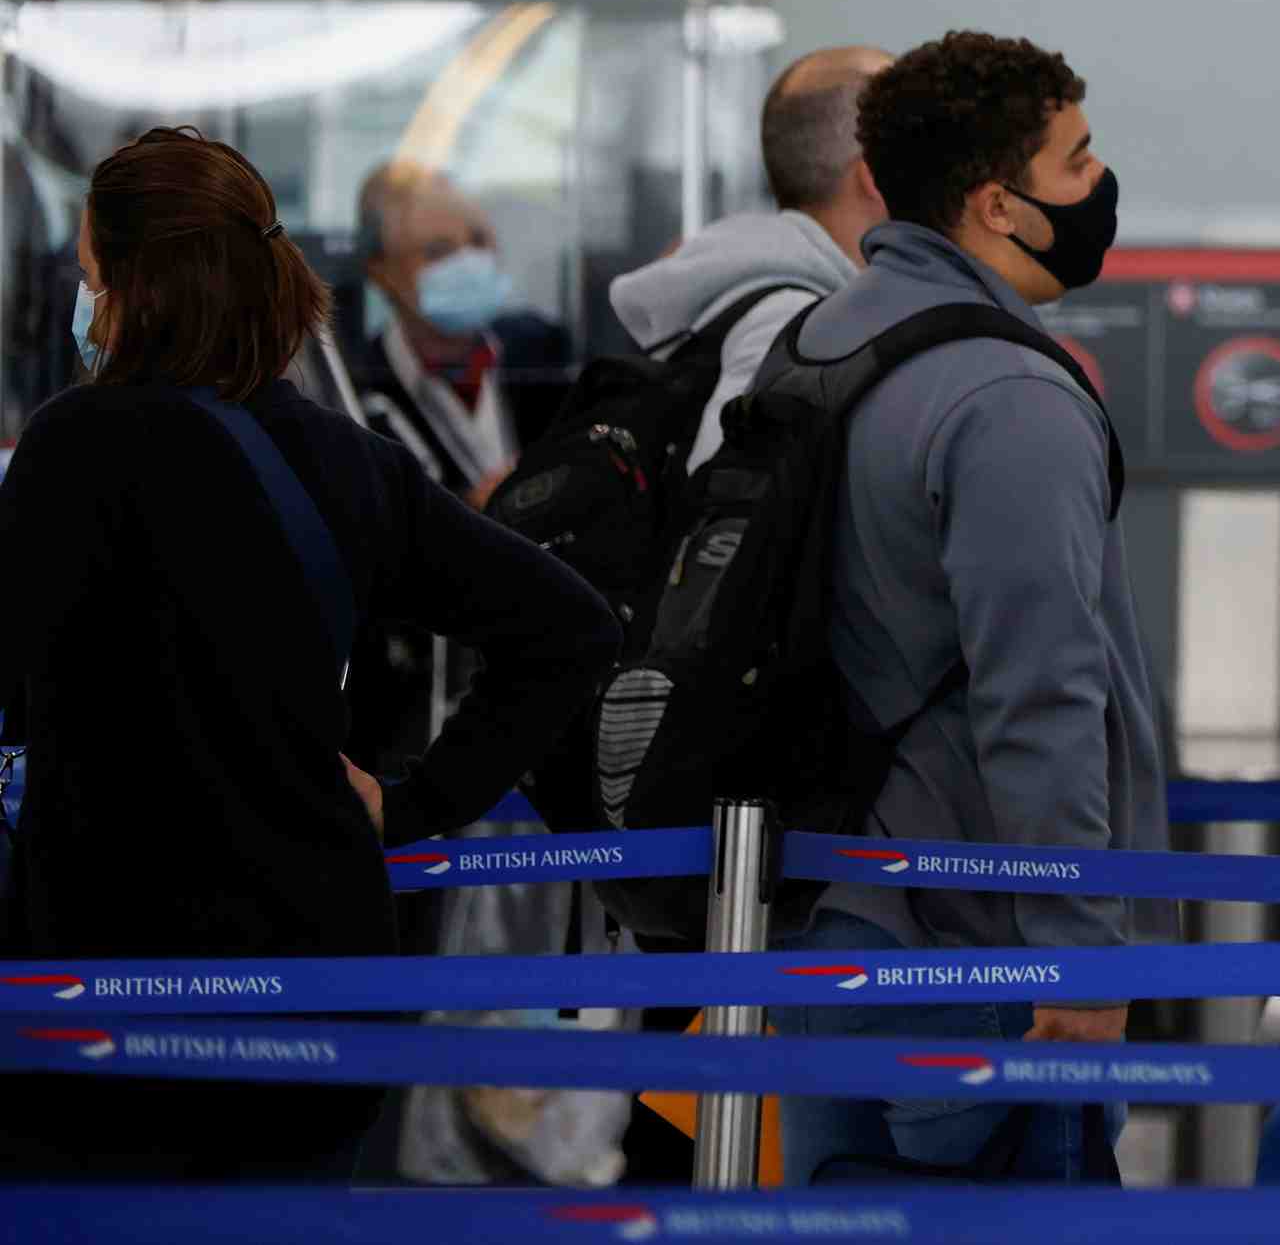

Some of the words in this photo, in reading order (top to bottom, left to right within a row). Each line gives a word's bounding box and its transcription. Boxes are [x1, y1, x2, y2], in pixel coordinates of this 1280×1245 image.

[459, 852, 536, 871] BRITISH
[541, 846, 623, 867] AIRWAYS
[917, 856, 994, 875] BRITISH
[998, 860, 1081, 880] AIRWAYS
[95, 977, 183, 996] BRITISH
[188, 976, 283, 995] AIRWAYS
[877, 966, 963, 986] BRITISH
[967, 964, 1061, 984] AIRWAYS
[124, 1034, 227, 1059] BRITISH
[231, 1037, 338, 1063] AIRWAYS
[1003, 1060, 1103, 1083] BRITISH
[1107, 1061, 1213, 1086] AIRWAYS
